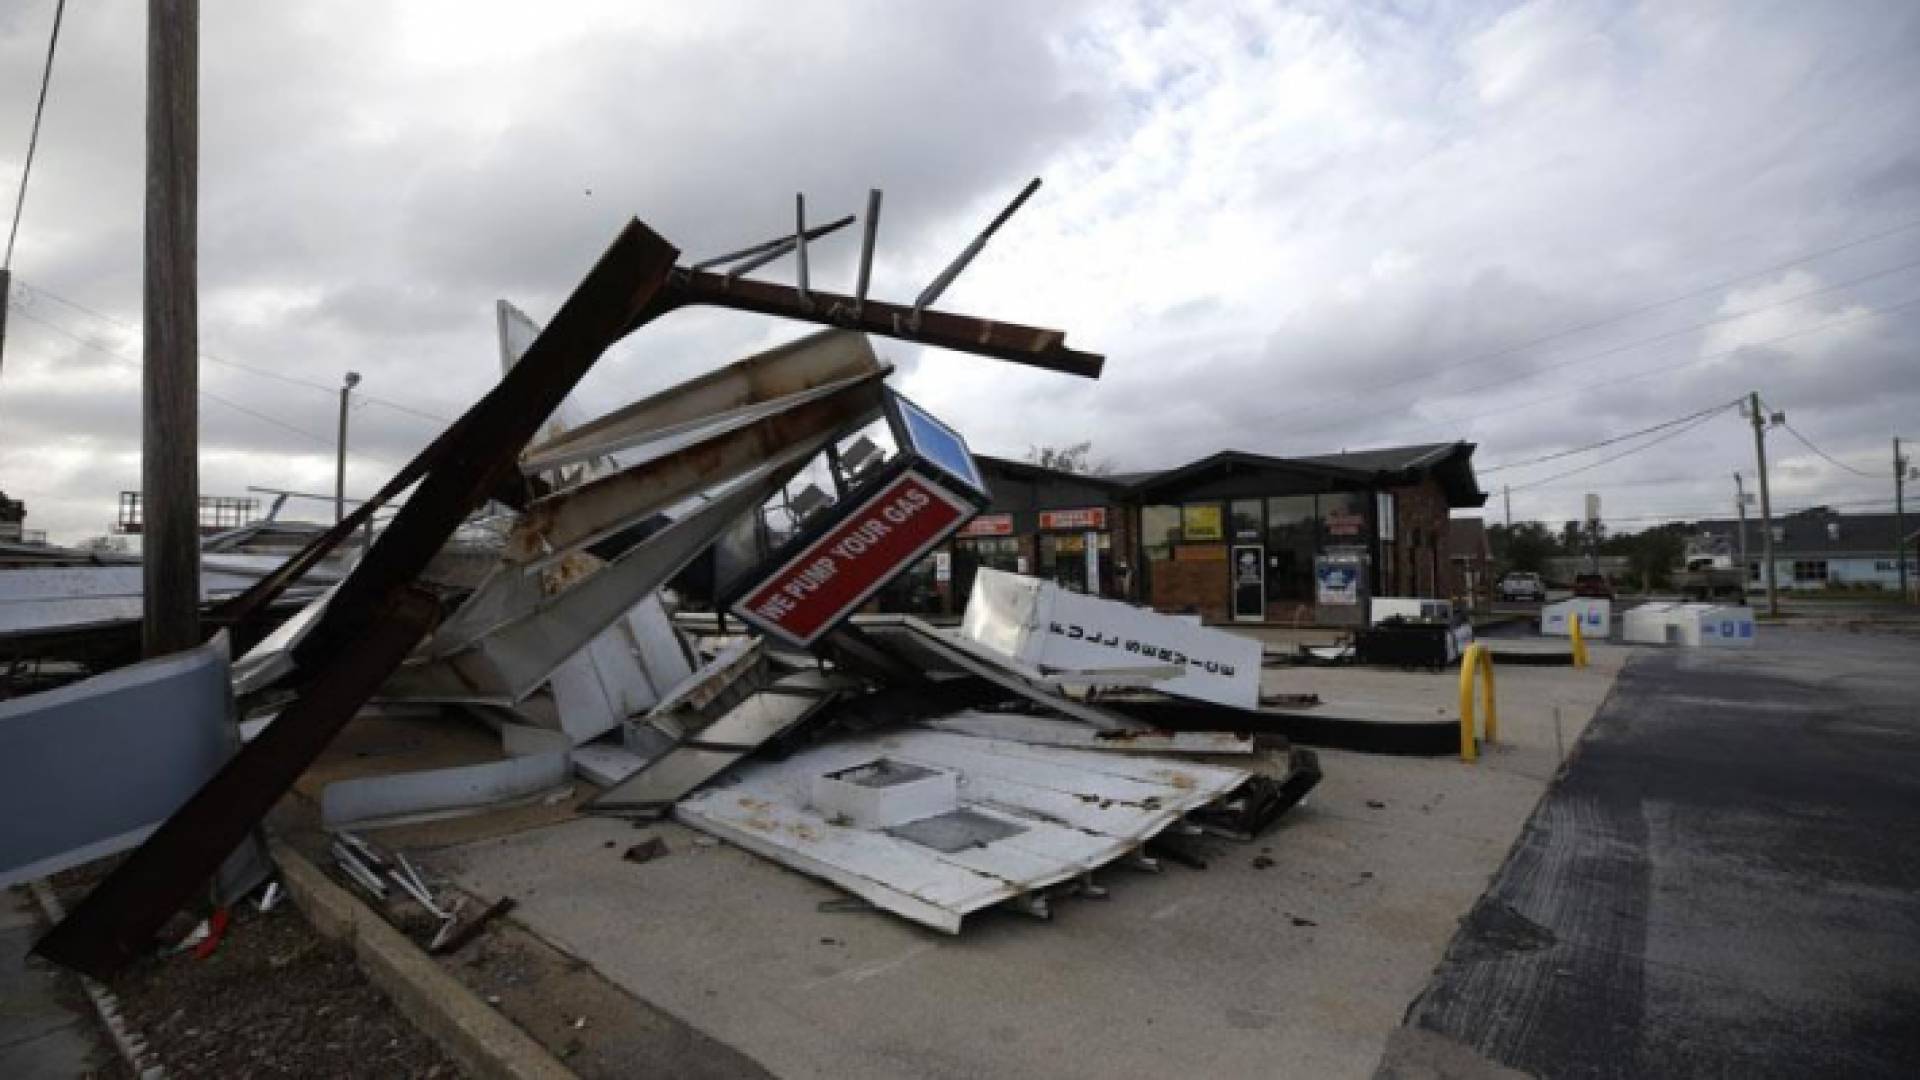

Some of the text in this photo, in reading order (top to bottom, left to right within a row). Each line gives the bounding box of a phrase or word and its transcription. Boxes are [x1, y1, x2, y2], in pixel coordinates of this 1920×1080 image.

[757, 488, 930, 620] WE PUMP YOUR GAS
[1050, 620, 1235, 676] FULL SERVICE
